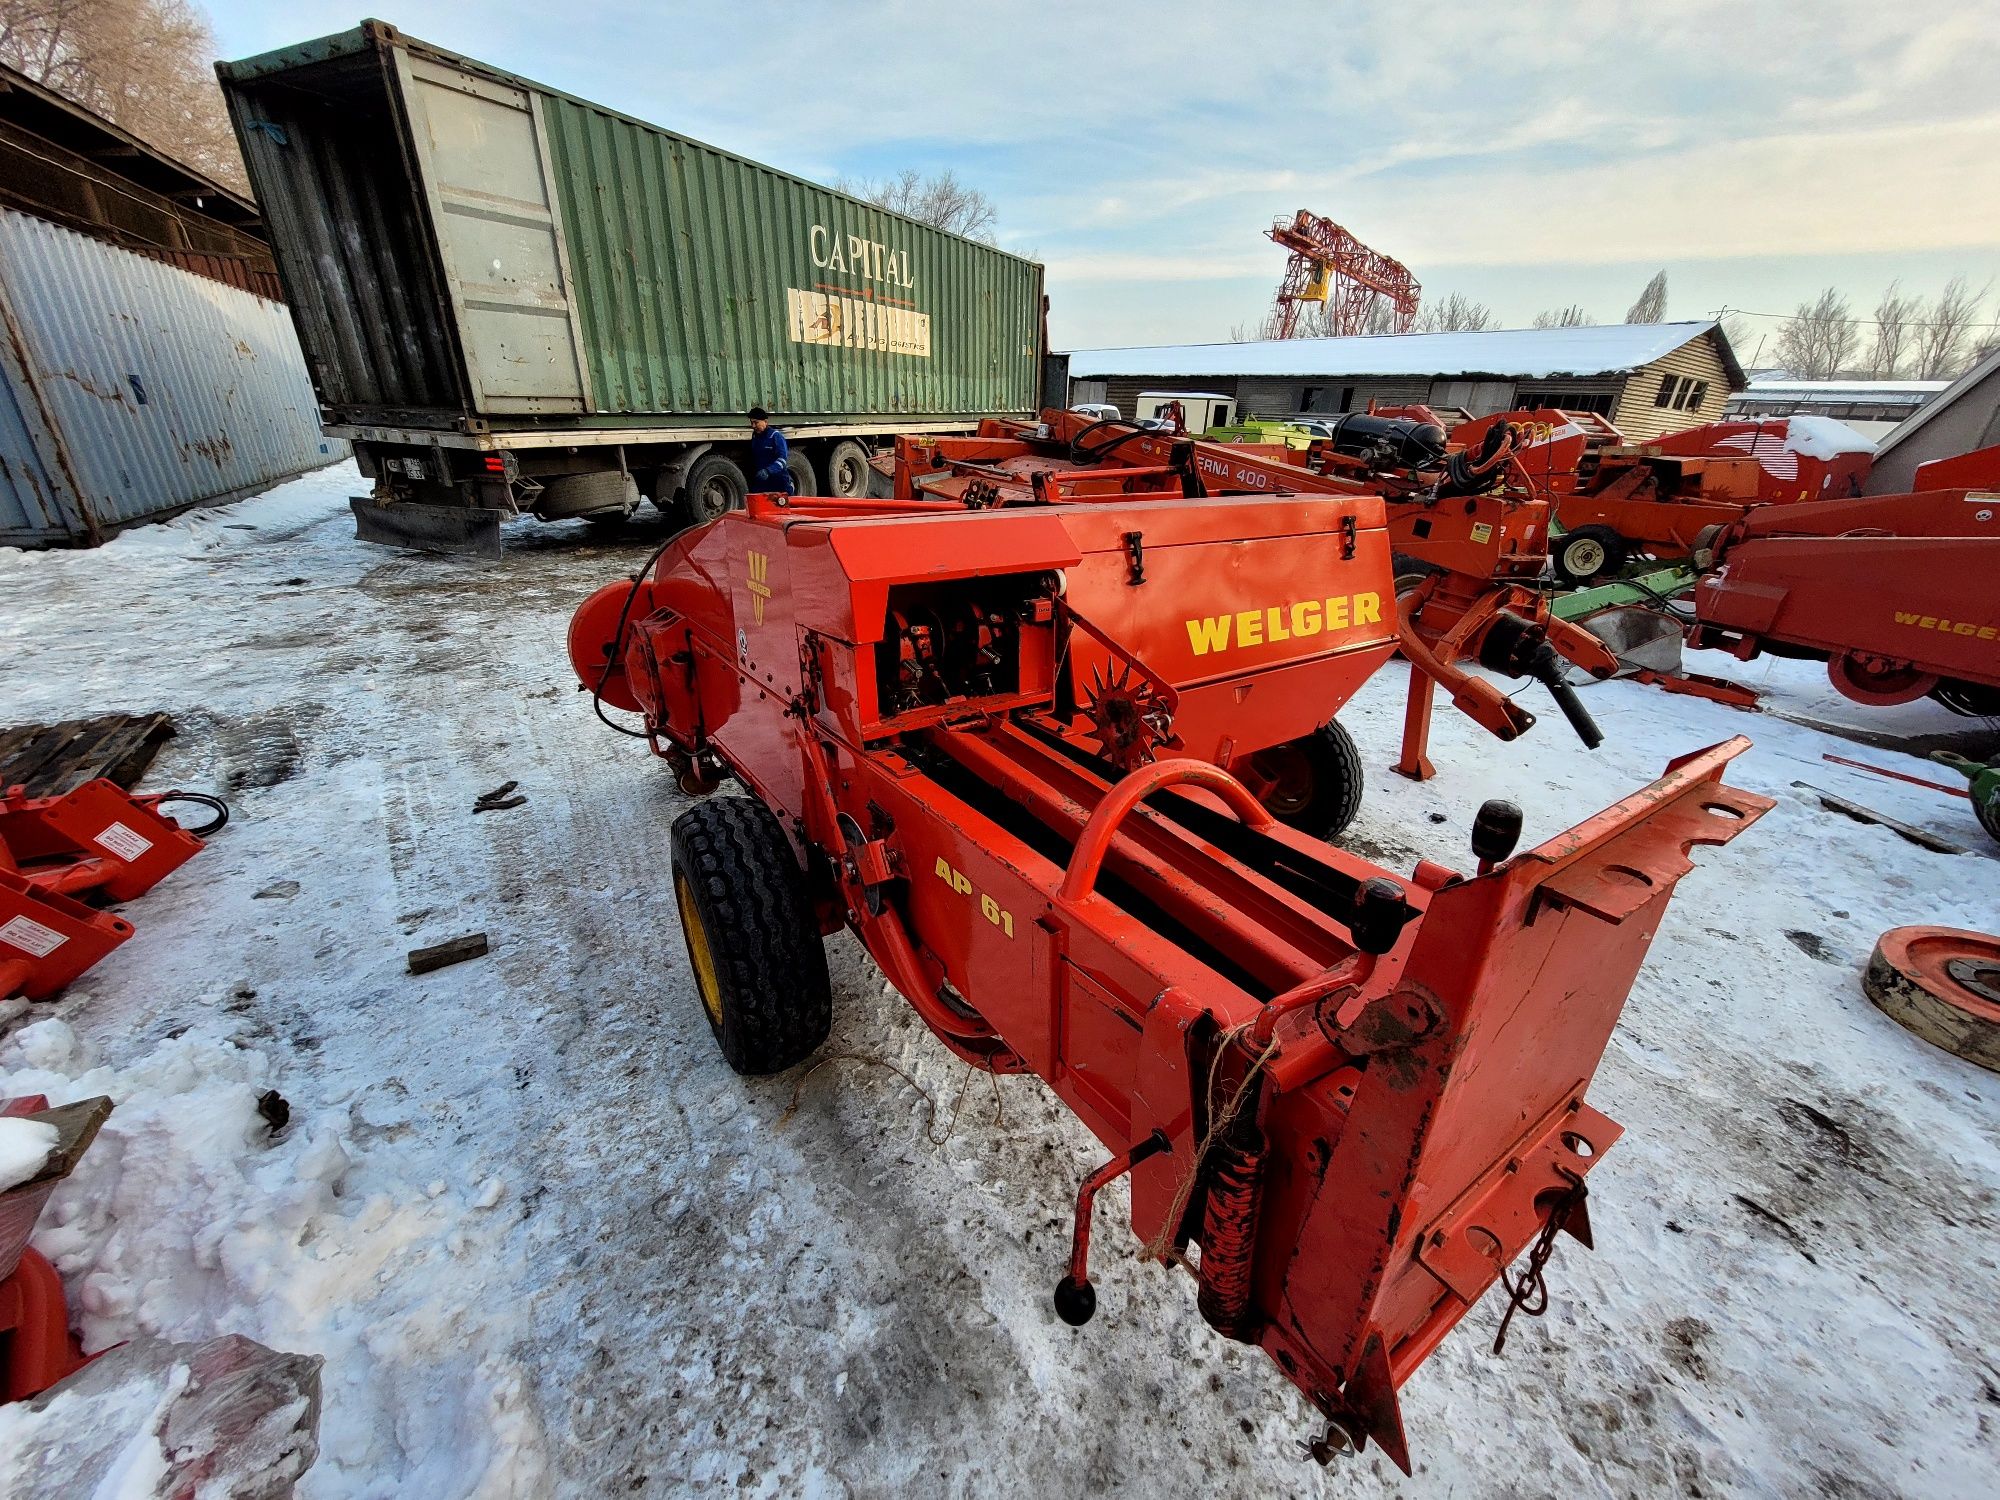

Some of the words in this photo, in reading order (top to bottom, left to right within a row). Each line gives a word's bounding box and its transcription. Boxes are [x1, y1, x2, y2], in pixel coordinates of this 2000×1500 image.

[811, 224, 914, 288] CAPITAL
[1197, 456, 1229, 478] ERNA
[1237, 469, 1267, 489] 400
[746, 578, 772, 599] WELGER
[1186, 591, 1381, 656] WELGER
[1894, 611, 2000, 641] WELGE
[935, 856, 973, 895] AP
[981, 893, 1014, 940] 61
